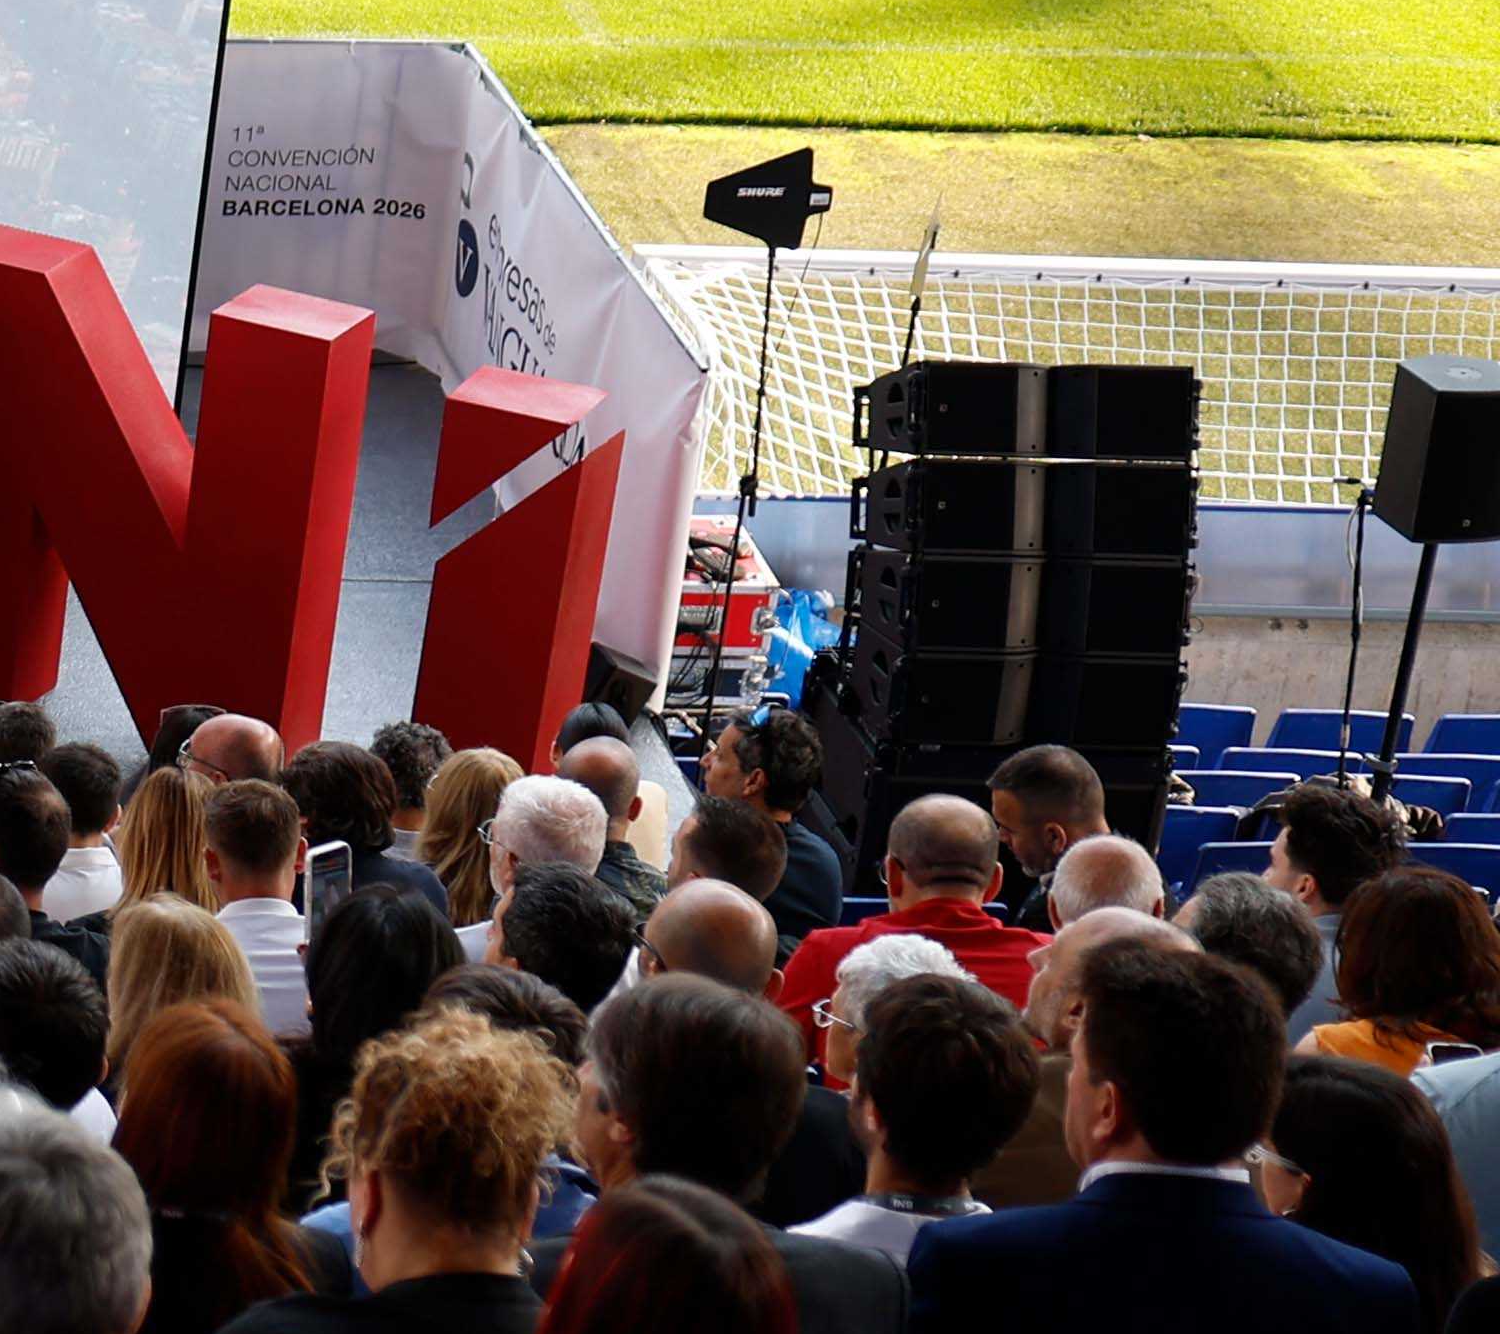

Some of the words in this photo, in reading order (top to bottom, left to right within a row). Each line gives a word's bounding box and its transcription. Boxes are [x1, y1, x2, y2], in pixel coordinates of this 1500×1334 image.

[228, 144, 375, 167] CONVENCIÓN
[225, 174, 337, 192] NACIONAL
[736, 187, 787, 197] SHURE
[222, 198, 365, 216] BARCELONA
[373, 198, 426, 219] 2026
